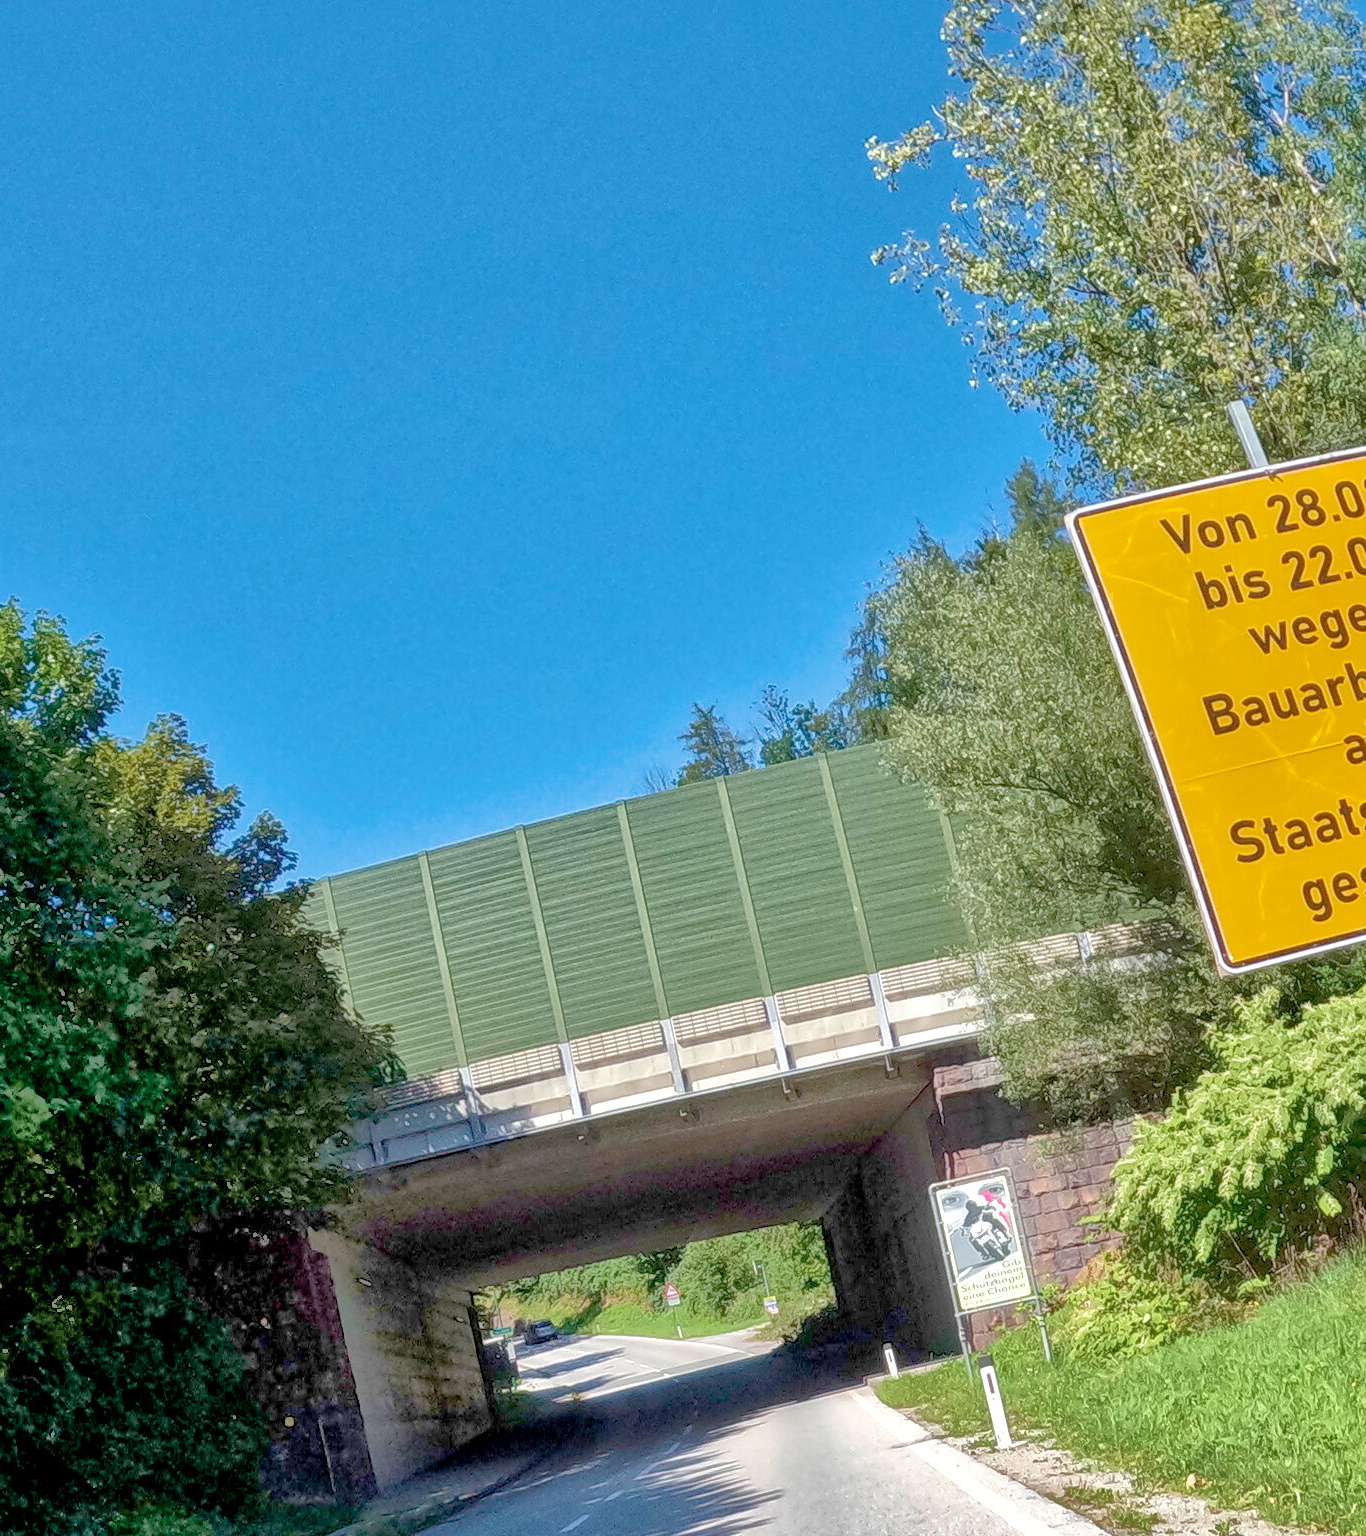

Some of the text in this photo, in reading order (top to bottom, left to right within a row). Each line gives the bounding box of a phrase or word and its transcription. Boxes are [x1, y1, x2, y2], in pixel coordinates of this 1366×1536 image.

[1160, 512, 1257, 555] Von
[1195, 566, 1271, 610] bis
[985, 1267, 1023, 1280] deinem
[1002, 1259, 1021, 1268] Gib
[961, 1271, 1025, 1293] Schutzengel
[963, 1283, 1026, 1301] eine Chance
